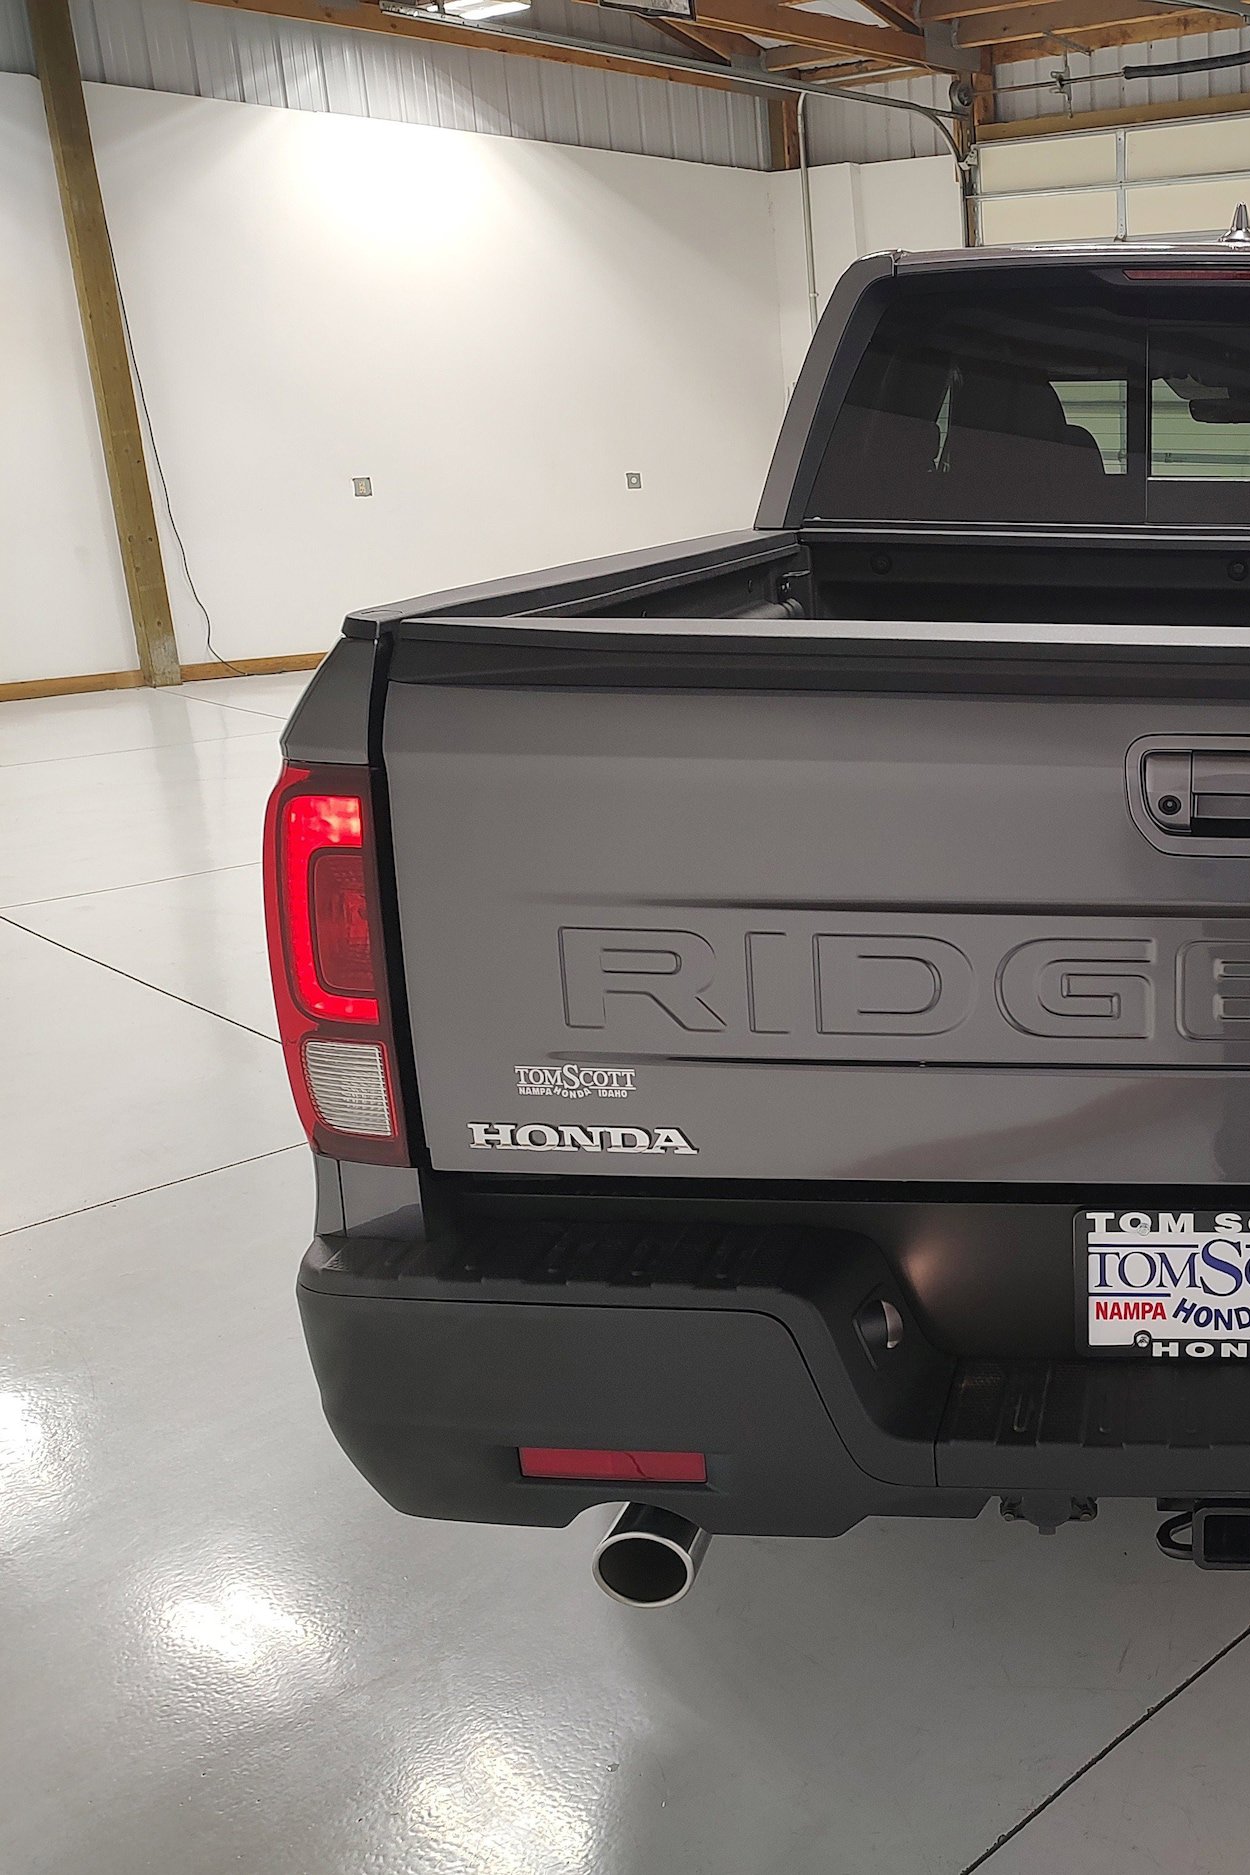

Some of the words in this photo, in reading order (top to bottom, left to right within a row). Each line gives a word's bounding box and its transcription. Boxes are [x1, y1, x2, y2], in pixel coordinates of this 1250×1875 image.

[518, 1086, 554, 1096] NAMPA
[553, 1086, 592, 1099] HONDA
[598, 1089, 628, 1098] IDAHO
[467, 1122, 700, 1155] HONDA
[1086, 1212, 1195, 1234] TOM
[1095, 1301, 1167, 1321] NAMPA
